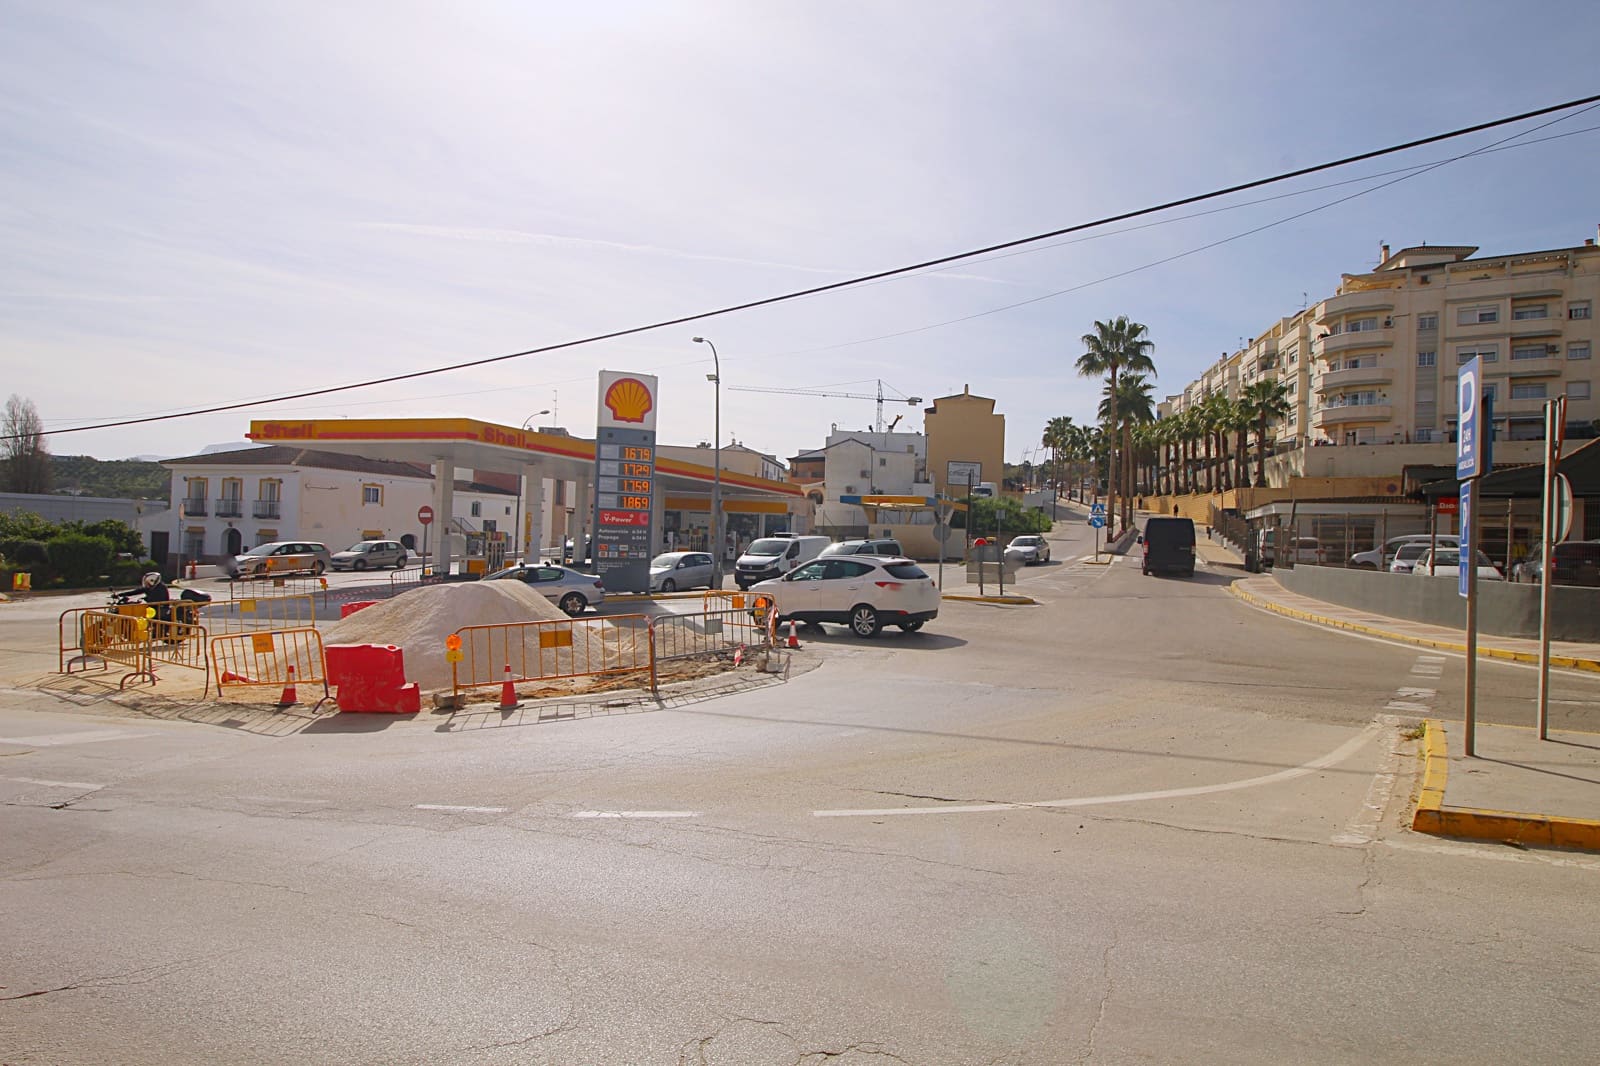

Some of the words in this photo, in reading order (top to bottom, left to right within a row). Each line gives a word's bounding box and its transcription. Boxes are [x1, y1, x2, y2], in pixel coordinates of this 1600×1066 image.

[1459, 371, 1475, 457] P
[263, 423, 313, 439] Shell
[483, 426, 526, 449] Shell
[603, 513, 632, 523] V-Power
